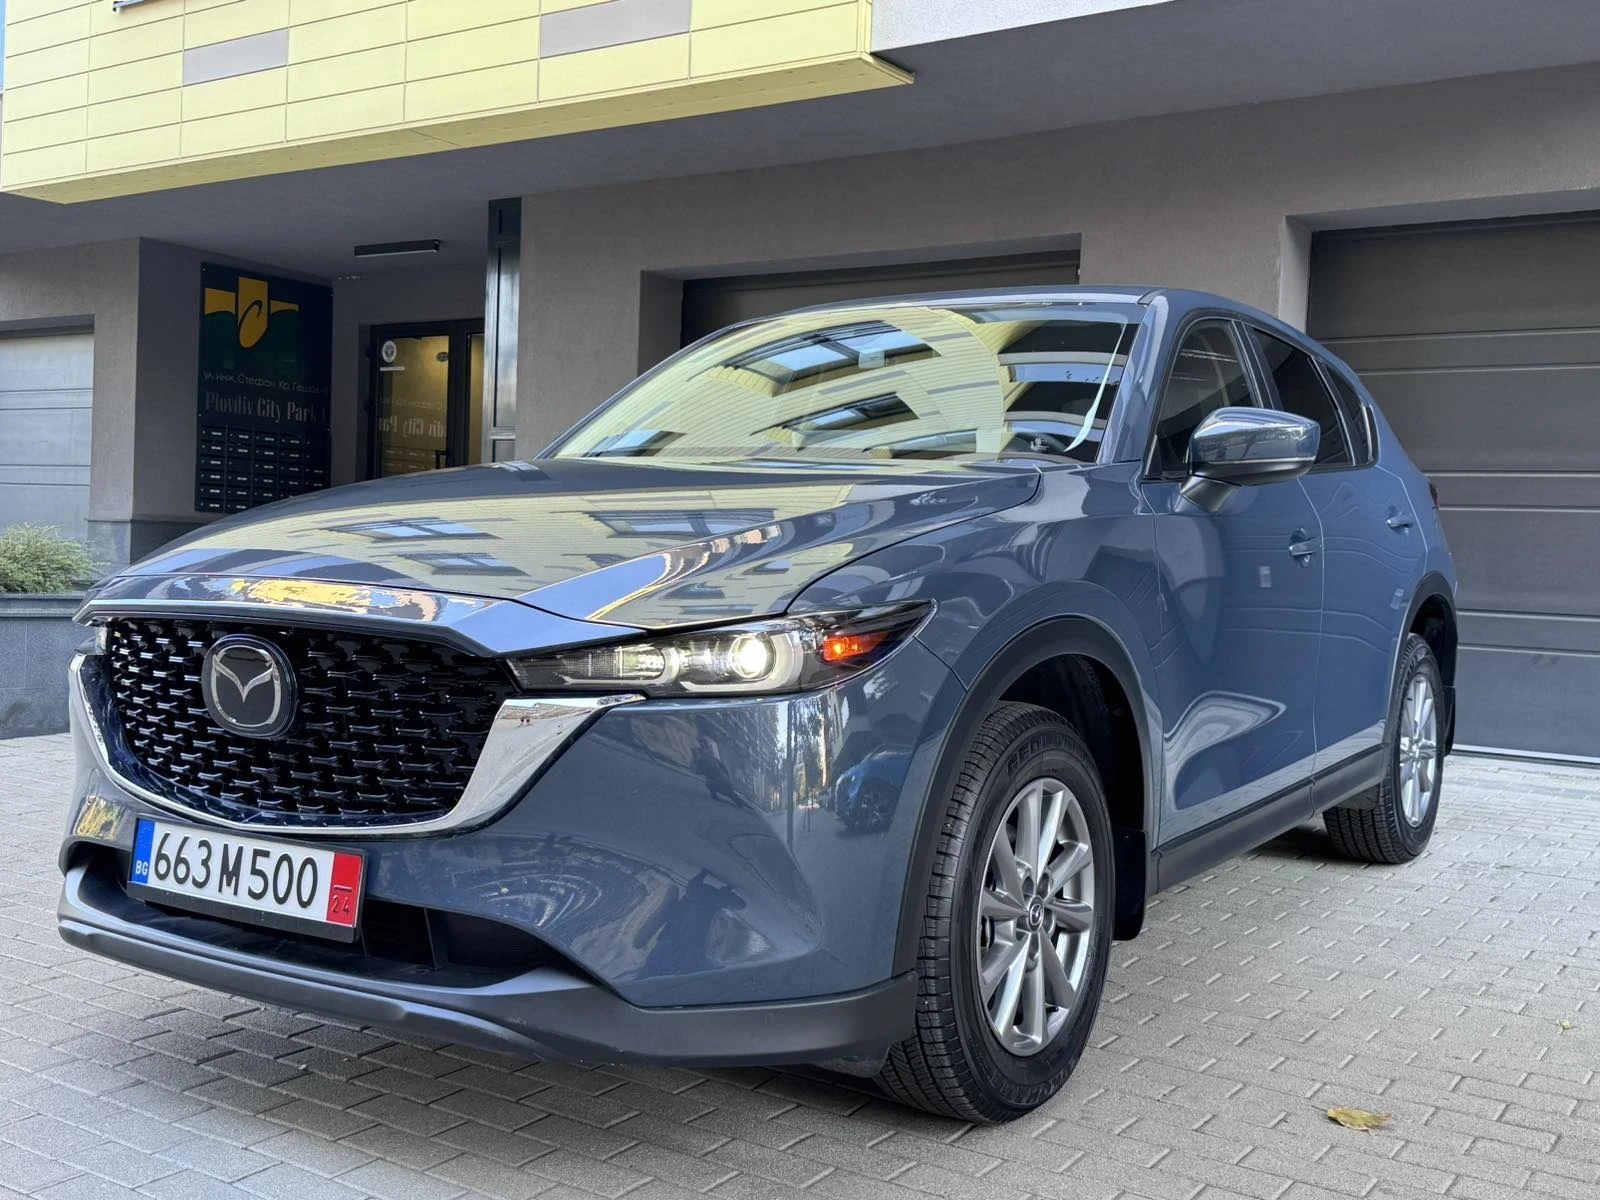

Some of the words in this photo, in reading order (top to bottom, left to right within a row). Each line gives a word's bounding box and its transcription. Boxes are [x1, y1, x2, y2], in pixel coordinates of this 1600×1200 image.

[206, 392, 252, 416] Plovdiv
[257, 398, 281, 423] City
[287, 401, 316, 424] Park
[135, 860, 149, 876] BG
[154, 832, 319, 909] 663M500
[331, 894, 350, 916] 24
